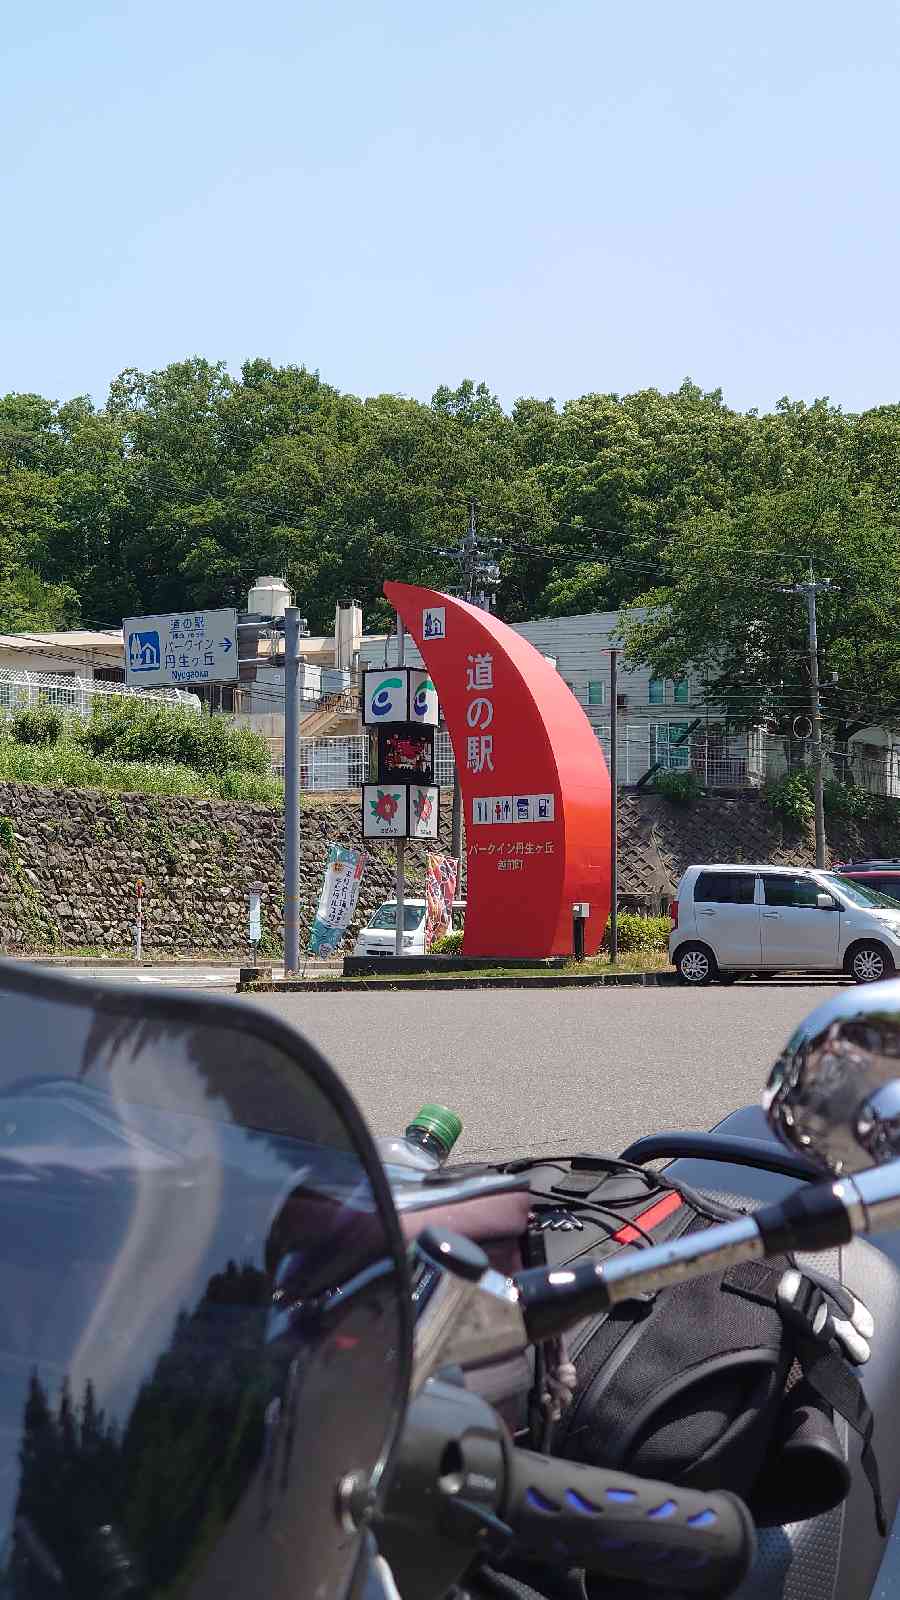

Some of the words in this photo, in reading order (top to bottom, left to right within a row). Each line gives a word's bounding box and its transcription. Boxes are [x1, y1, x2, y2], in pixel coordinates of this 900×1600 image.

[169, 616, 205, 631] 道の駅
[165, 640, 214, 653] パークイン
[466, 652, 494, 774] 道の駅
